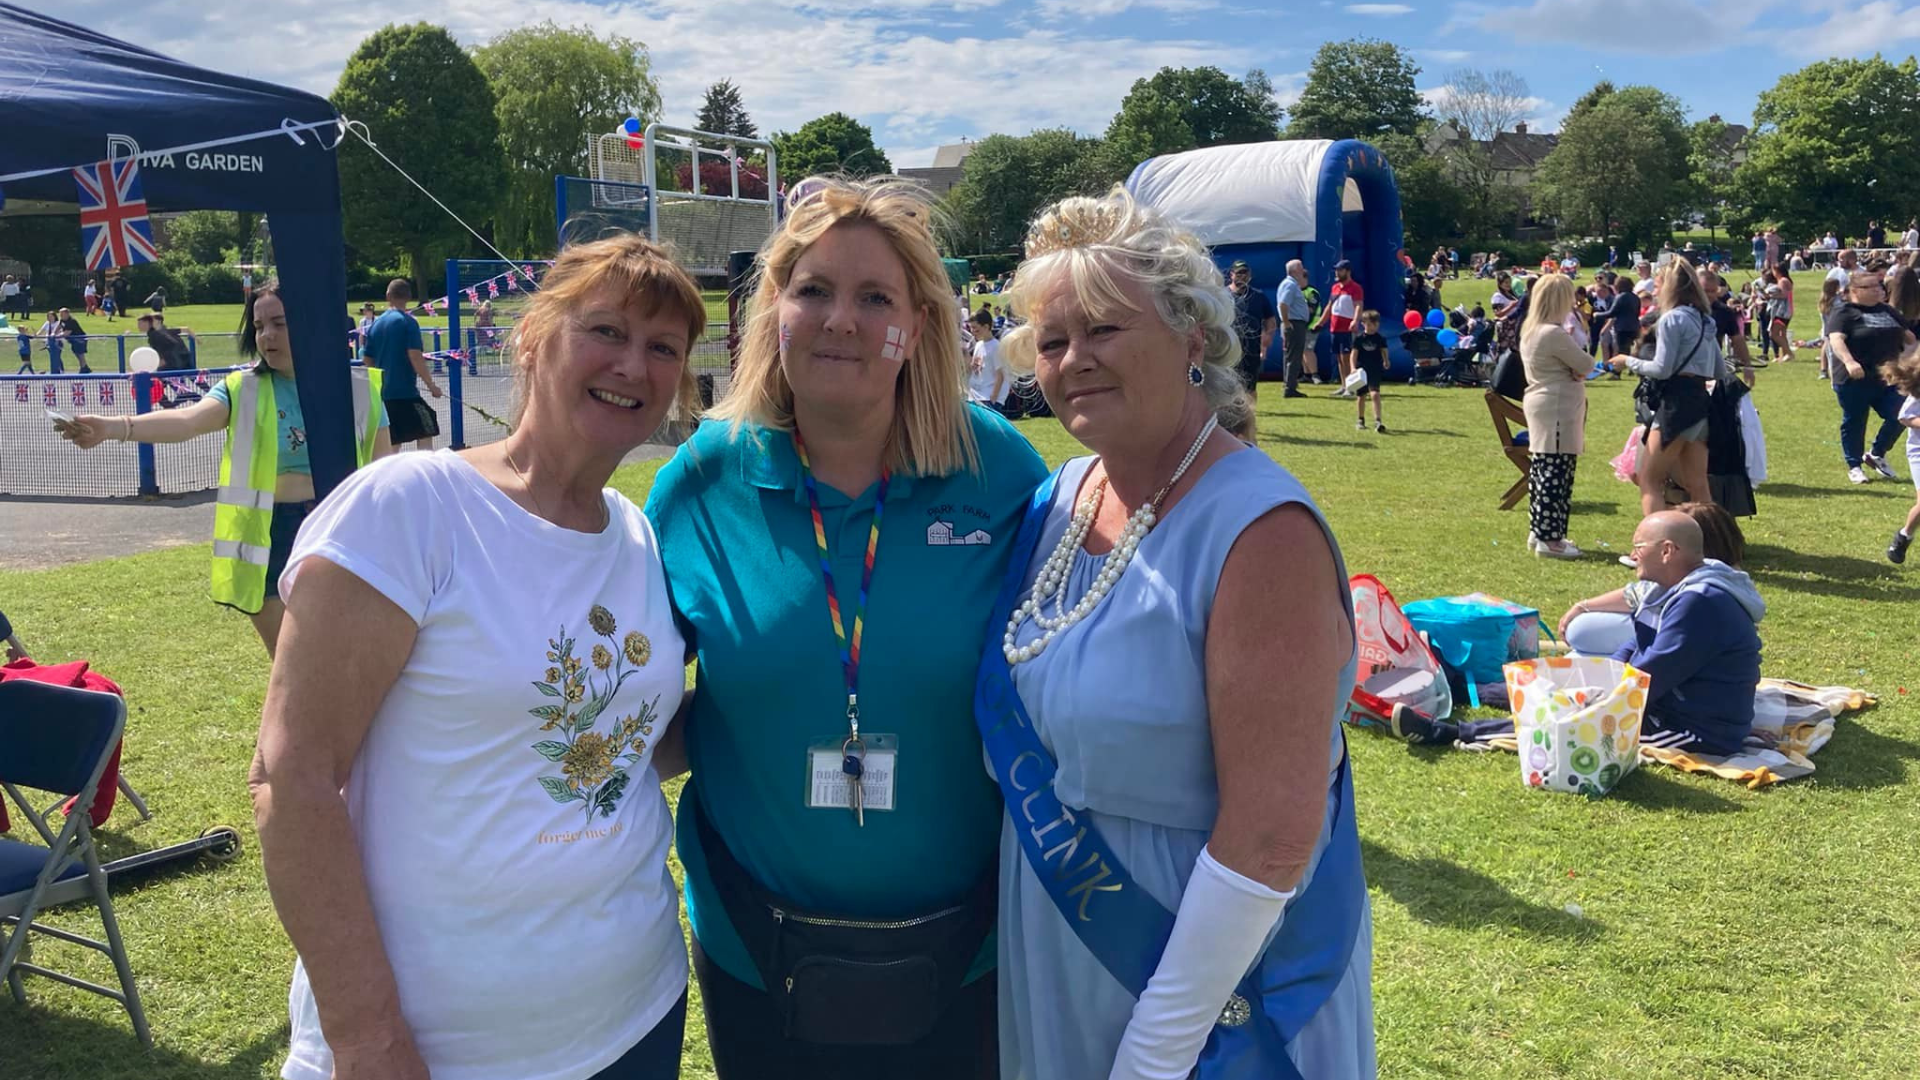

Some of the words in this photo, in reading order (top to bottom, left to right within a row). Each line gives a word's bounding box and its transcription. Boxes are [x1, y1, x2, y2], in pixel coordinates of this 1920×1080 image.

[106, 133, 175, 168] DIVA
[185, 152, 263, 172] GARDEN
[927, 504, 955, 518] PARK
[962, 504, 991, 520] FARM
[585, 828, 607, 839] me
[1009, 750, 1123, 922] CLINK
